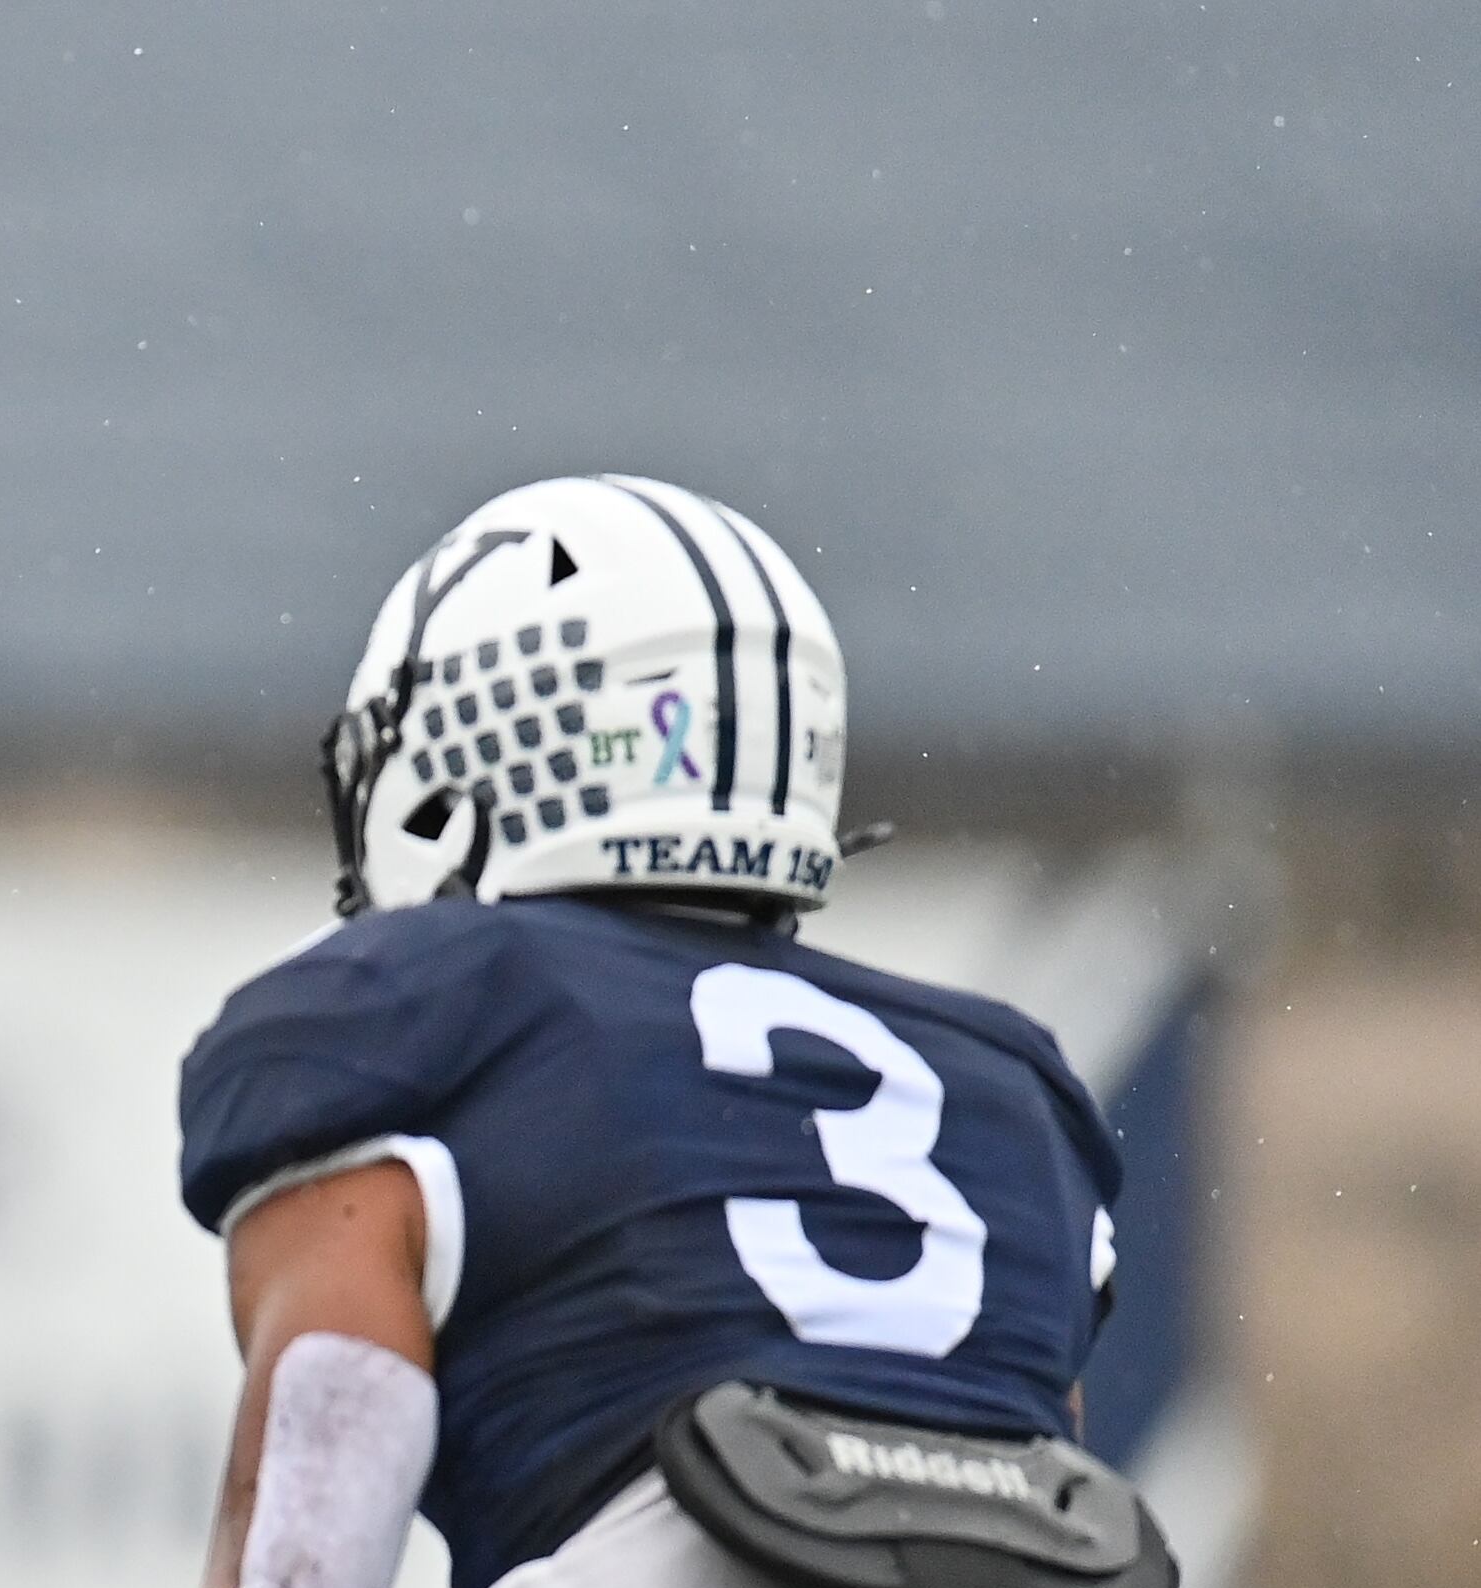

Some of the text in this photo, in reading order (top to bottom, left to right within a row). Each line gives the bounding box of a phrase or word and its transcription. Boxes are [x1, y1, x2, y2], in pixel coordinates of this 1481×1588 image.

[591, 727, 641, 765] BT
[603, 836, 775, 877] TEAM
[690, 962, 987, 1359] 3
[825, 1431, 1032, 1502] Riddell
